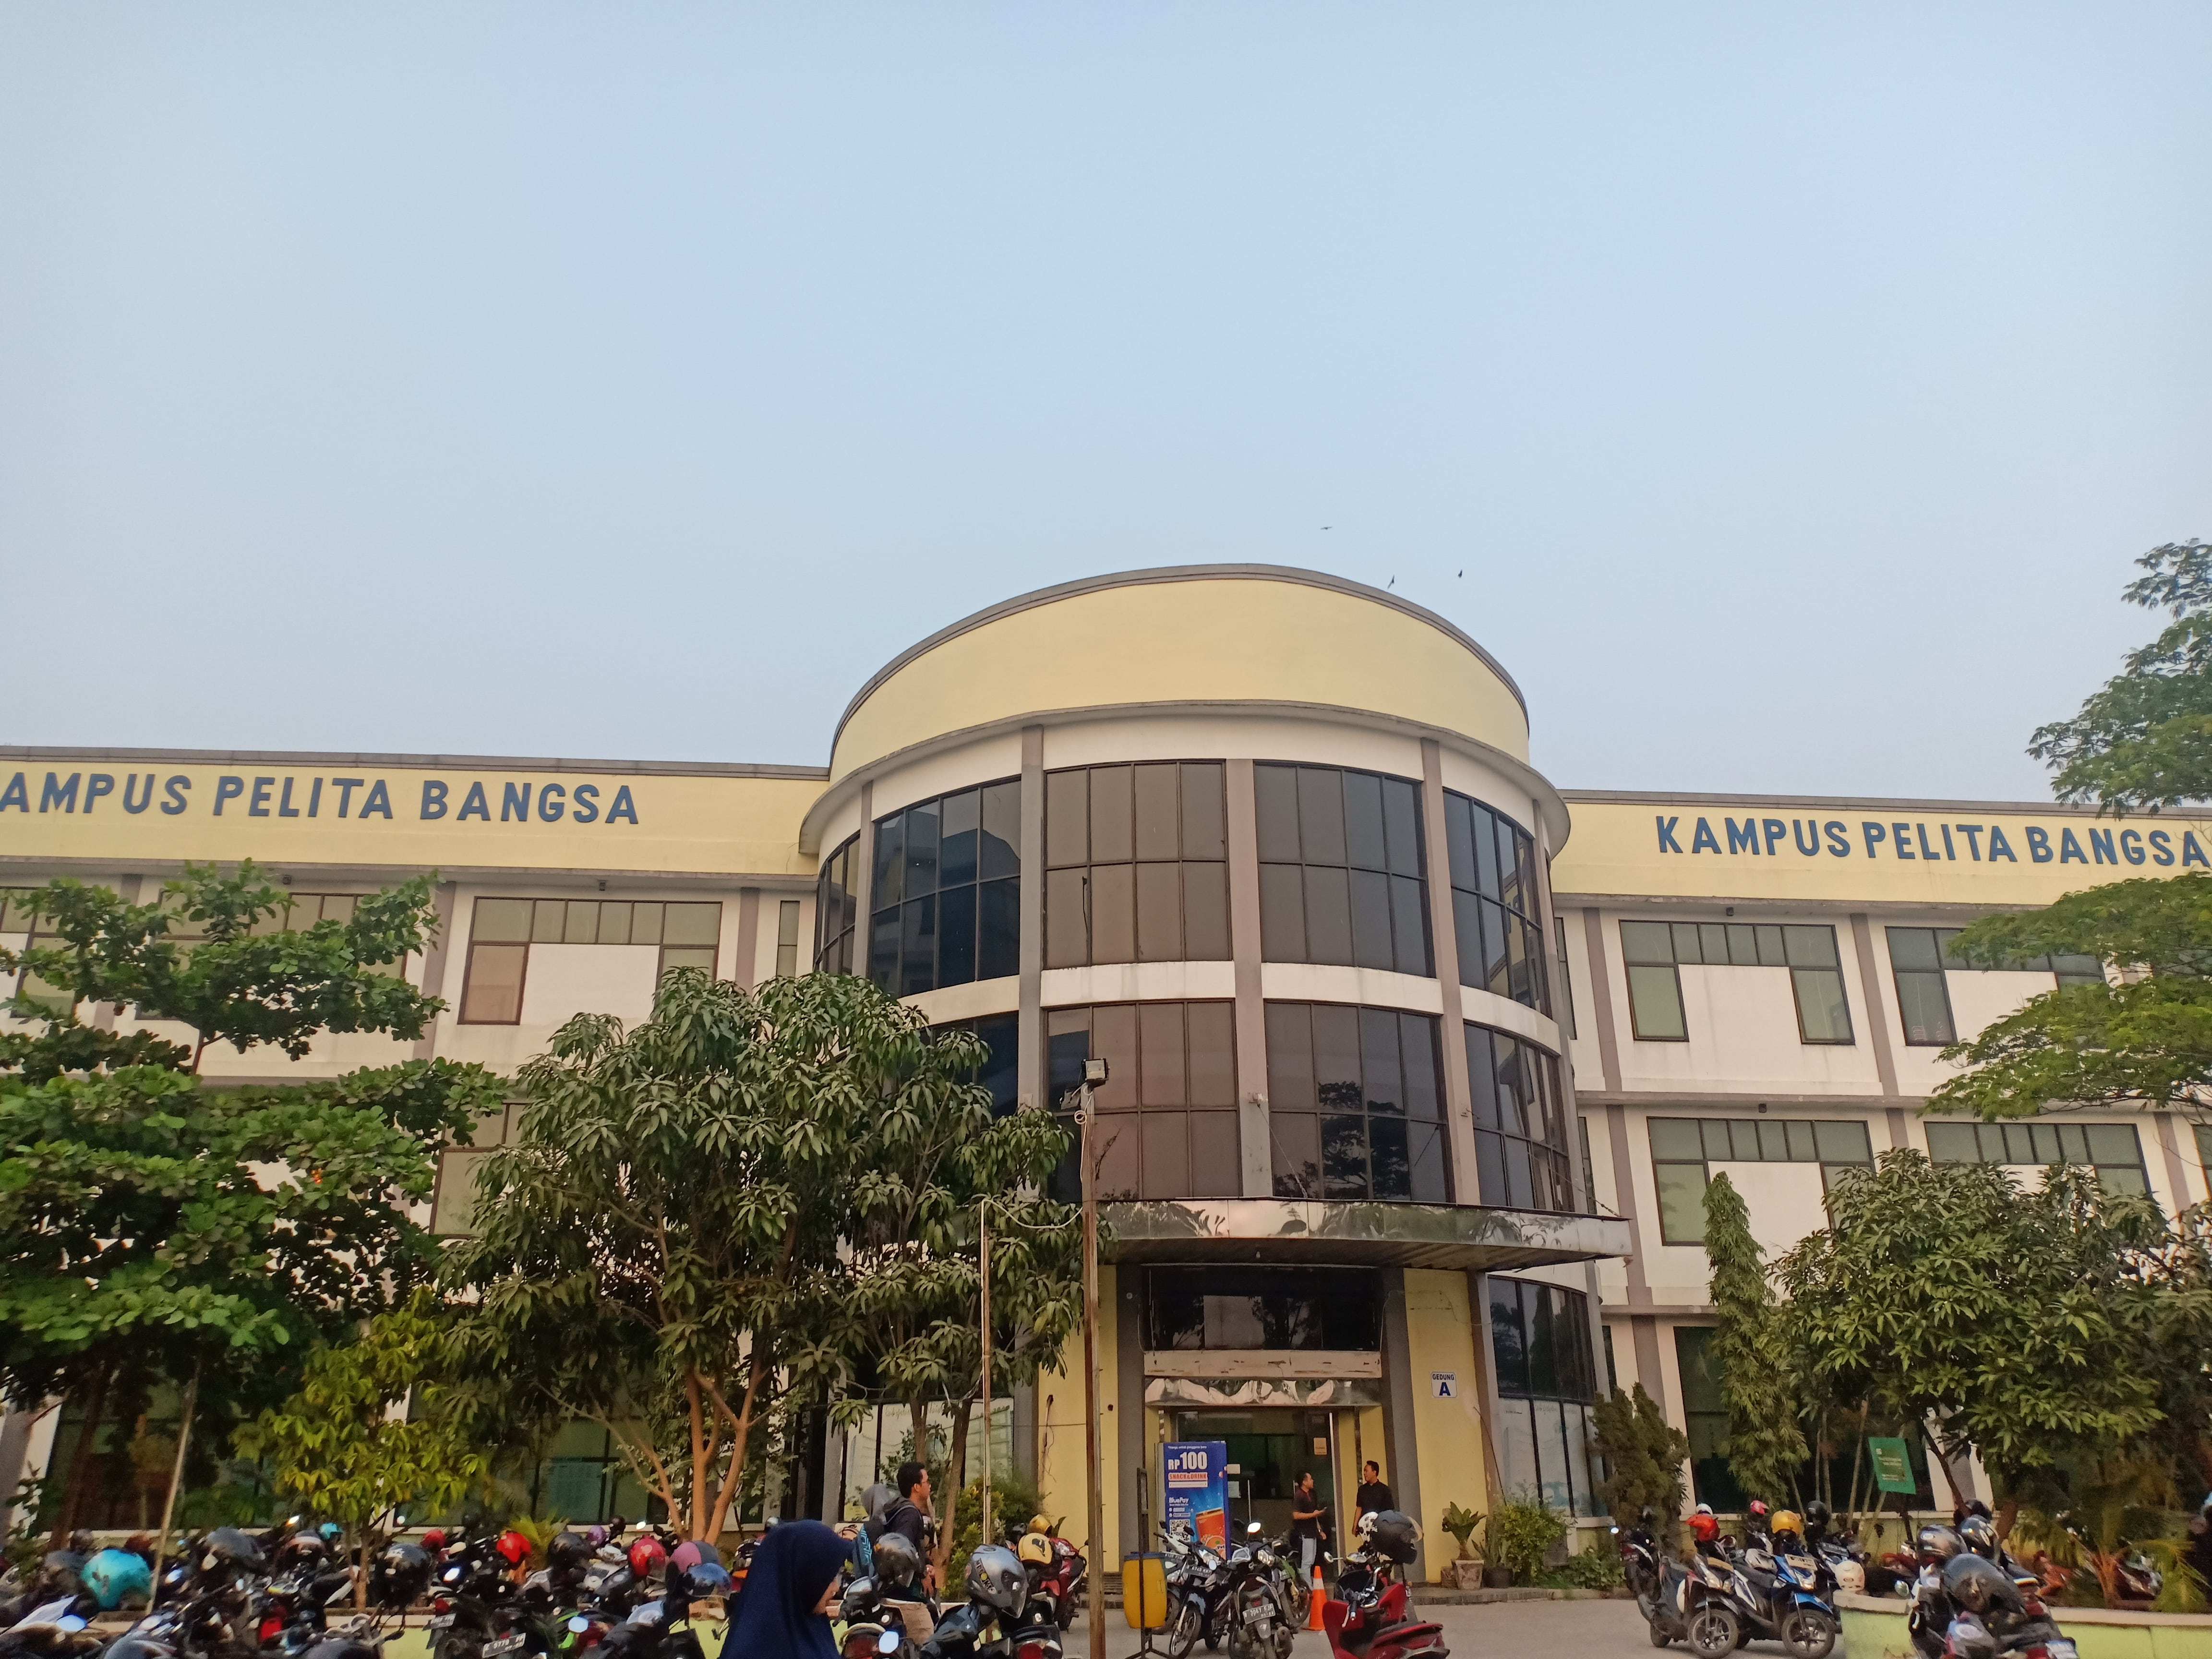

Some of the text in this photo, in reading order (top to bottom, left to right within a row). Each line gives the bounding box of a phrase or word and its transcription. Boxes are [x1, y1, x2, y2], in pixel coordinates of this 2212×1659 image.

[213, 776, 393, 819] PELITA
[420, 780, 638, 824] BANGSA
[1656, 816, 2211, 867] KAMPUS PELITA BANGSA
[1439, 1382, 1451, 1395] A
[1168, 1452, 1207, 1470] RP 100
